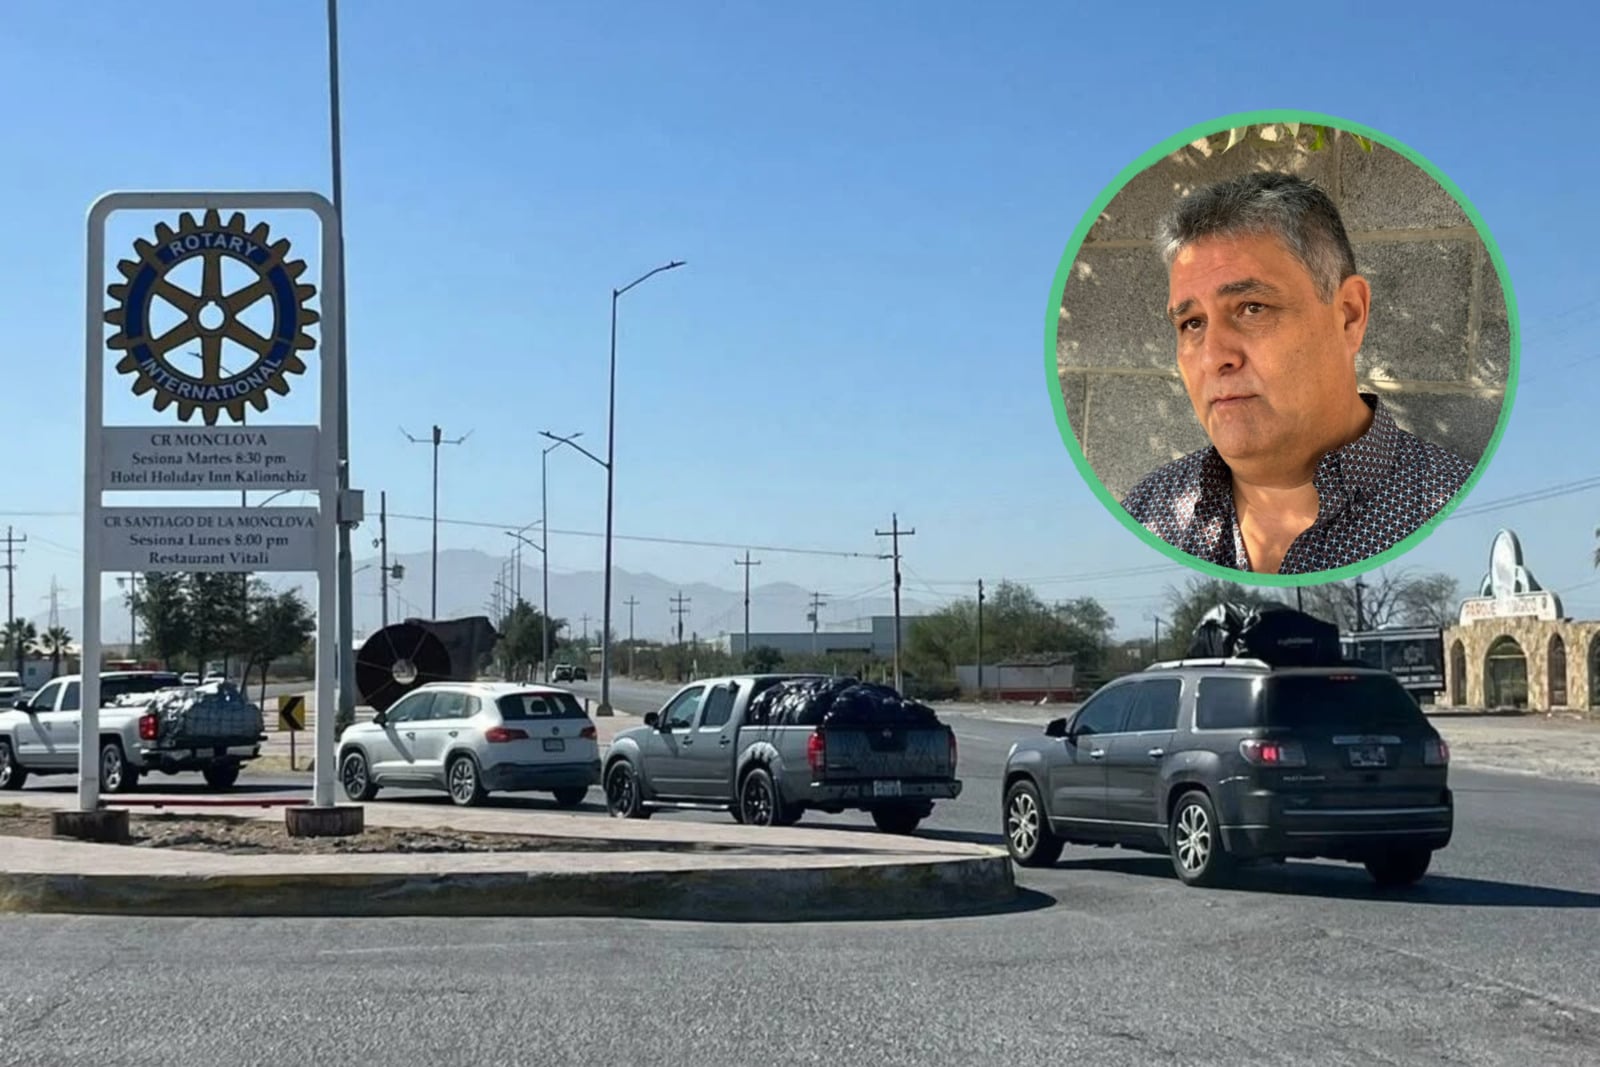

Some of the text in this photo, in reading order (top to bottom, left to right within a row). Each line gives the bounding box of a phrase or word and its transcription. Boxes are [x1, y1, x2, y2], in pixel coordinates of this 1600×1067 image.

[170, 233, 258, 257] ROTARY
[141, 359, 282, 399] INTERNATIONAL
[151, 433, 267, 447] CR MONCLOVA
[132, 451, 287, 468] Sesiona Martes 8:30 pm
[111, 470, 307, 487] Hotel Holiday Inn Kalionchiz
[104, 516, 314, 528] CR SANTIAGO DE LA MONCLOVA
[130, 534, 289, 550] Sesiona Lunes 8:00 pm
[149, 552, 269, 565] Restaurant Vitali
